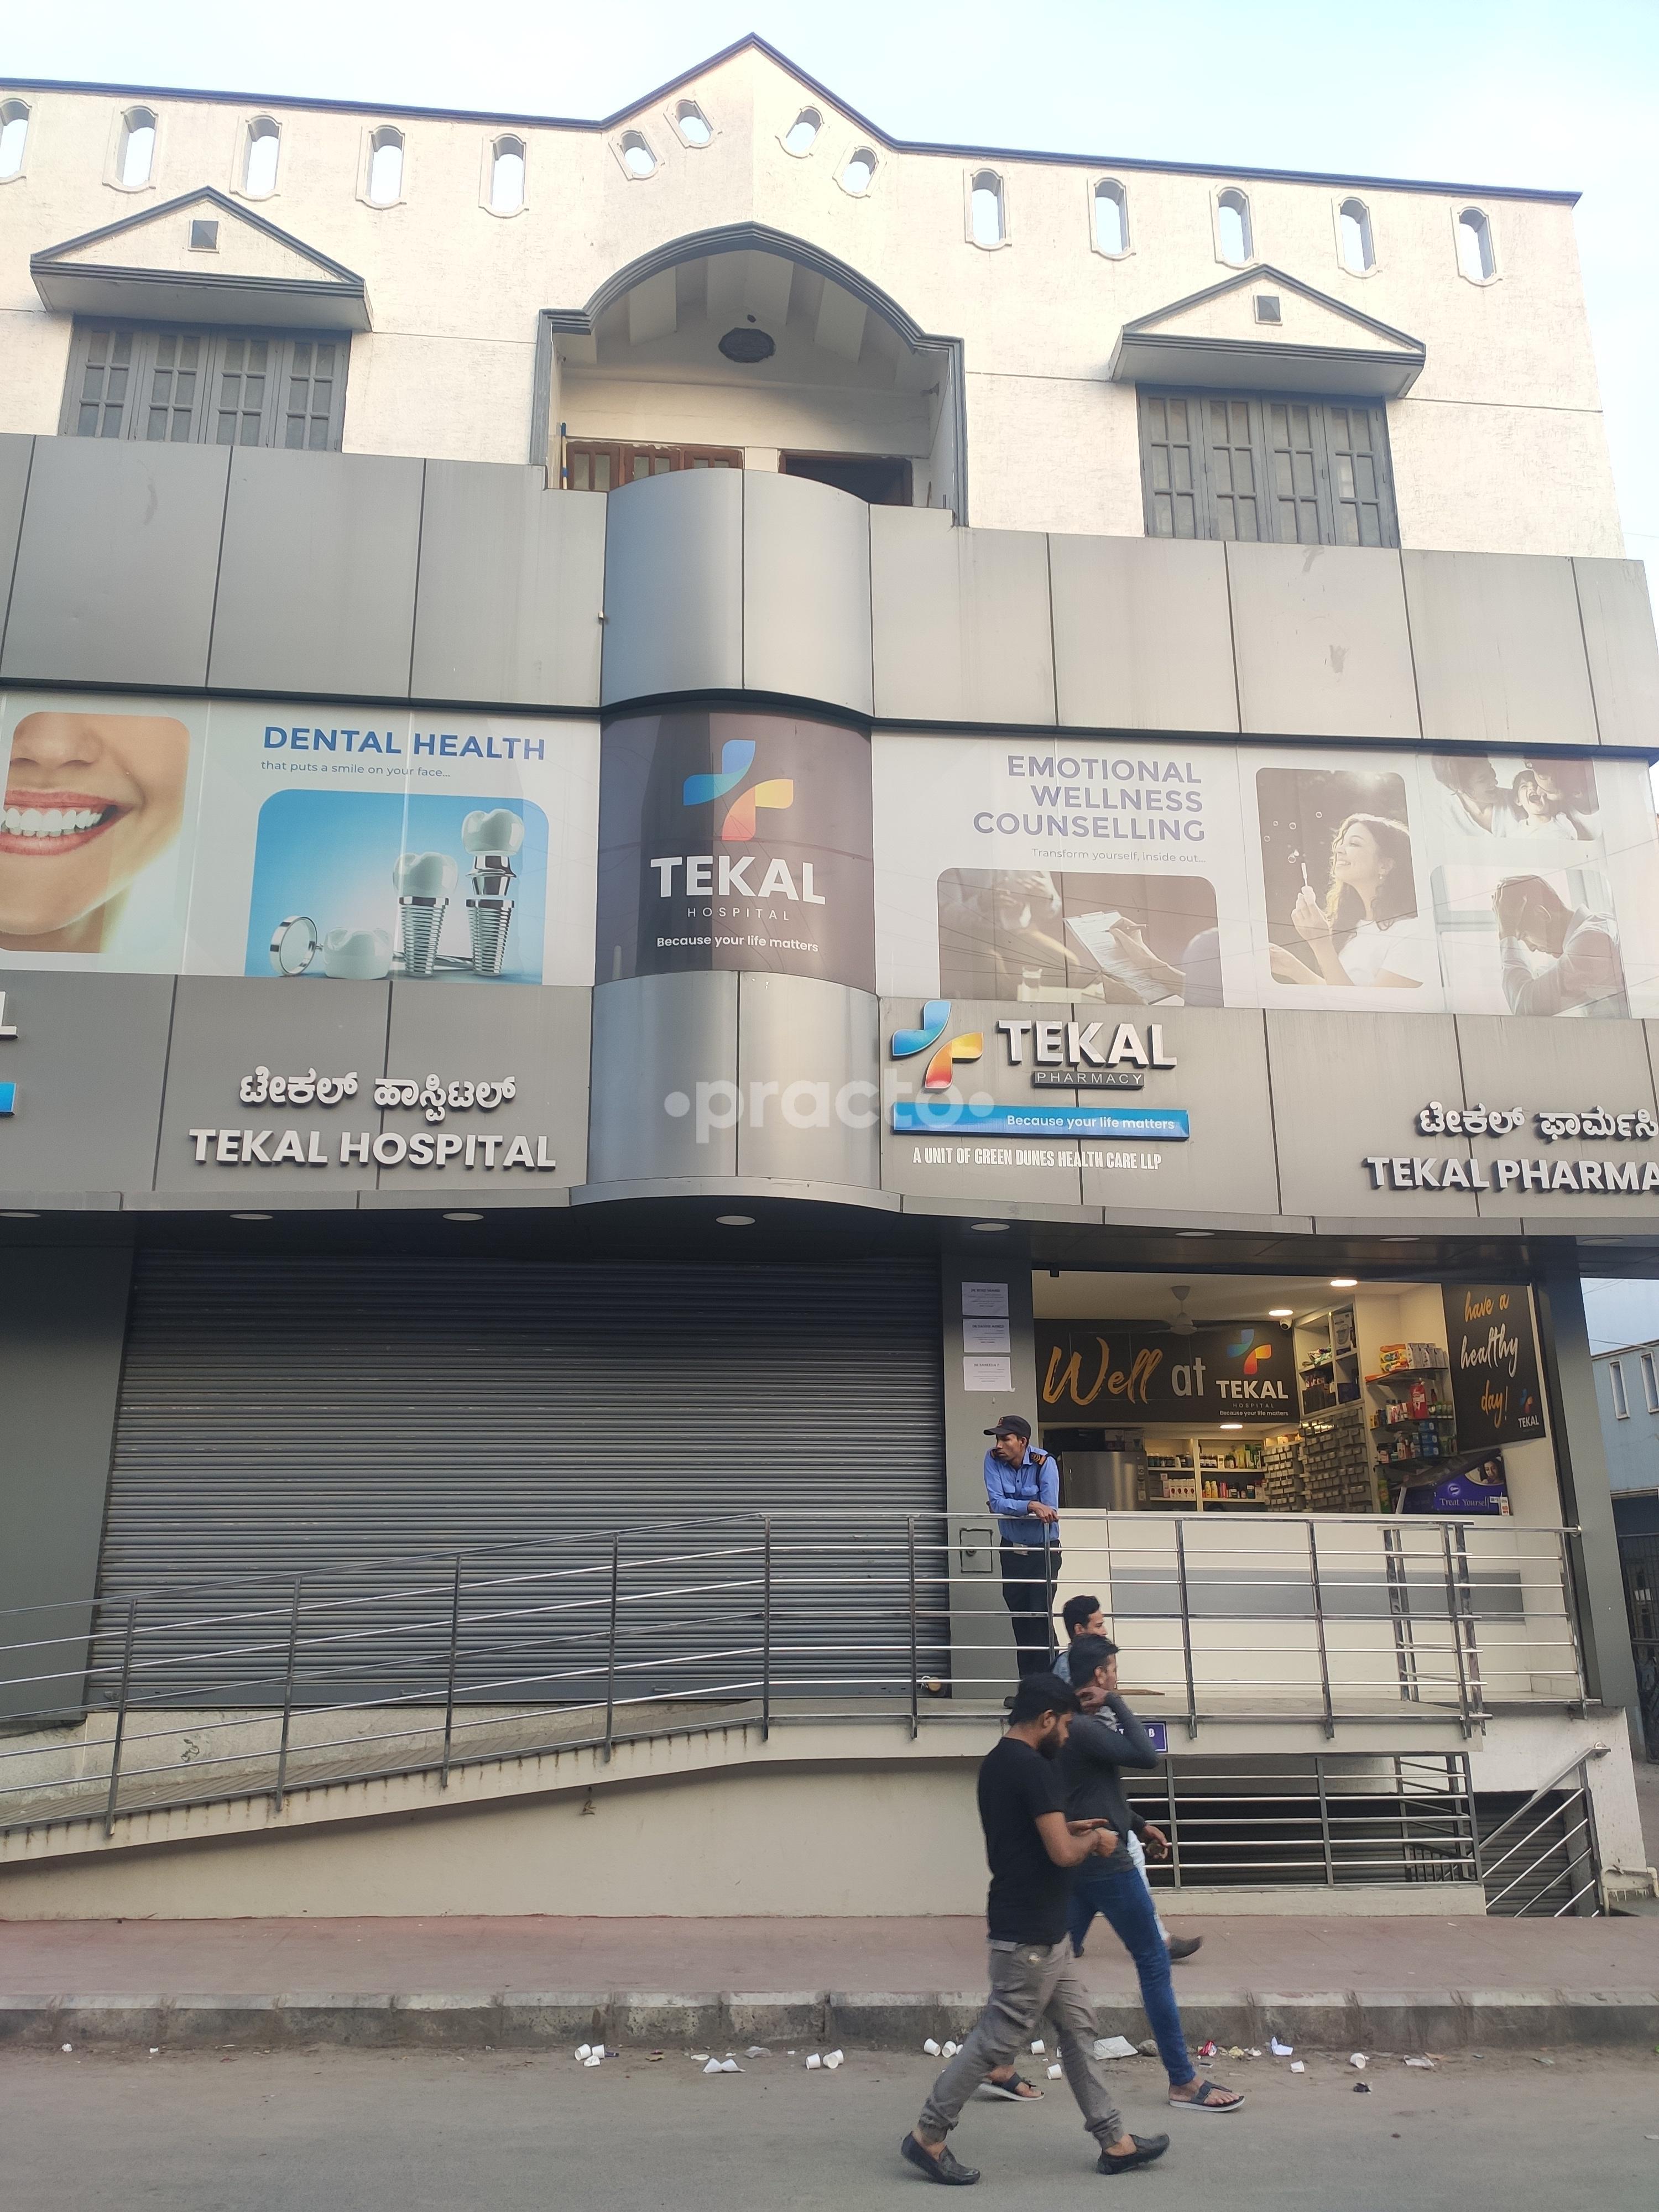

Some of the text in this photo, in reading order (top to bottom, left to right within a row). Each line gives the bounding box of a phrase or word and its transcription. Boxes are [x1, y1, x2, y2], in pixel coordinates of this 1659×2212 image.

[264, 726, 545, 760] DENTAL HEALTH
[261, 760, 286, 770] that
[290, 762, 317, 773] puts
[331, 764, 364, 773] smile
[387, 768, 414, 776] your
[1008, 755, 1201, 784] EMOTIONAL
[1030, 785, 1203, 812] WELLNESS
[973, 812, 1204, 841] COUNSELLING
[1031, 848, 1089, 859] Transform
[1092, 852, 1139, 862] yourself,
[1143, 852, 1176, 862] inside
[650, 855, 826, 905] TEKAL
[687, 907, 789, 921] HOSPITAL
[657, 935, 818, 952] Because your life matters
[998, 1020, 1177, 1067] TEKAL
[239, 1066, 358, 1104] ಟೇಕಲ್
[1037, 1072, 1142, 1084] PHARMACY
[1006, 1115, 1175, 1129] Because your life matters
[1420, 1101, 1525, 1134] ಟೇಕಲ್
[189, 1129, 556, 1168] TEKAL HOSPITAL
[913, 1147, 1162, 1170] A UNIT OF GREEN DUNES HEALTH CARE LLP
[1366, 1157, 1490, 1188] TEKAL
[1465, 1291, 1509, 1322] have a
[1460, 1323, 1518, 1378] healthy
[1042, 1337, 1206, 1405] Well at
[1216, 1380, 1288, 1399] TEKAL
[1481, 1379, 1509, 1429] day!
[1518, 1415, 1539, 1428] TEKAL
[1439, 1498, 1460, 1506] Treat
